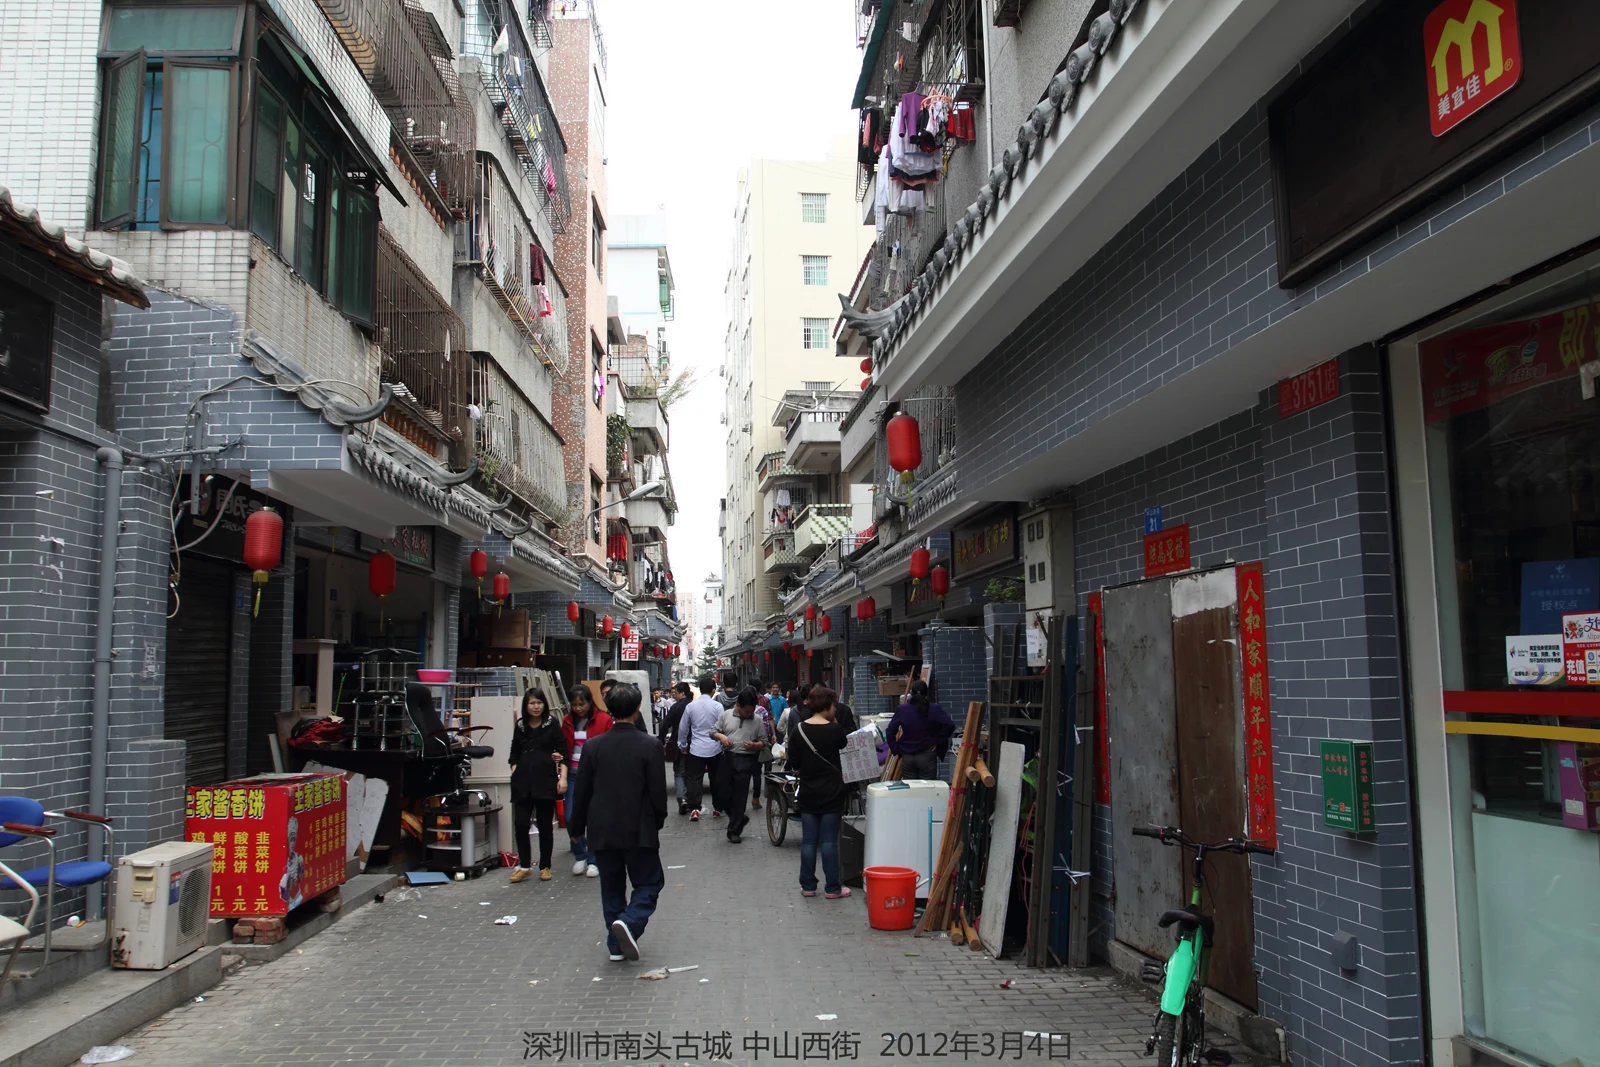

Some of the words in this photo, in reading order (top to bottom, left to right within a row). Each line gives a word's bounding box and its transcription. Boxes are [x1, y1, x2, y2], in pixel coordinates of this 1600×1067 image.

[1437, 74, 1481, 120] 美宜佳
[1293, 363, 1336, 409] 3751店
[1150, 517, 1157, 531] 21
[1541, 600, 1578, 611] 授权点
[1566, 659, 1586, 675] 充值
[847, 735, 867, 751] 回收
[295, 776, 341, 814] 土家酱香饼
[212, 832, 227, 874] 鲜肉饼
[233, 832, 249, 874] 酸菜饼
[255, 832, 270, 874] 韭菜饼
[211, 885, 225, 911] 1元
[232, 885, 247, 911] 1元
[254, 885, 269, 911] 1元
